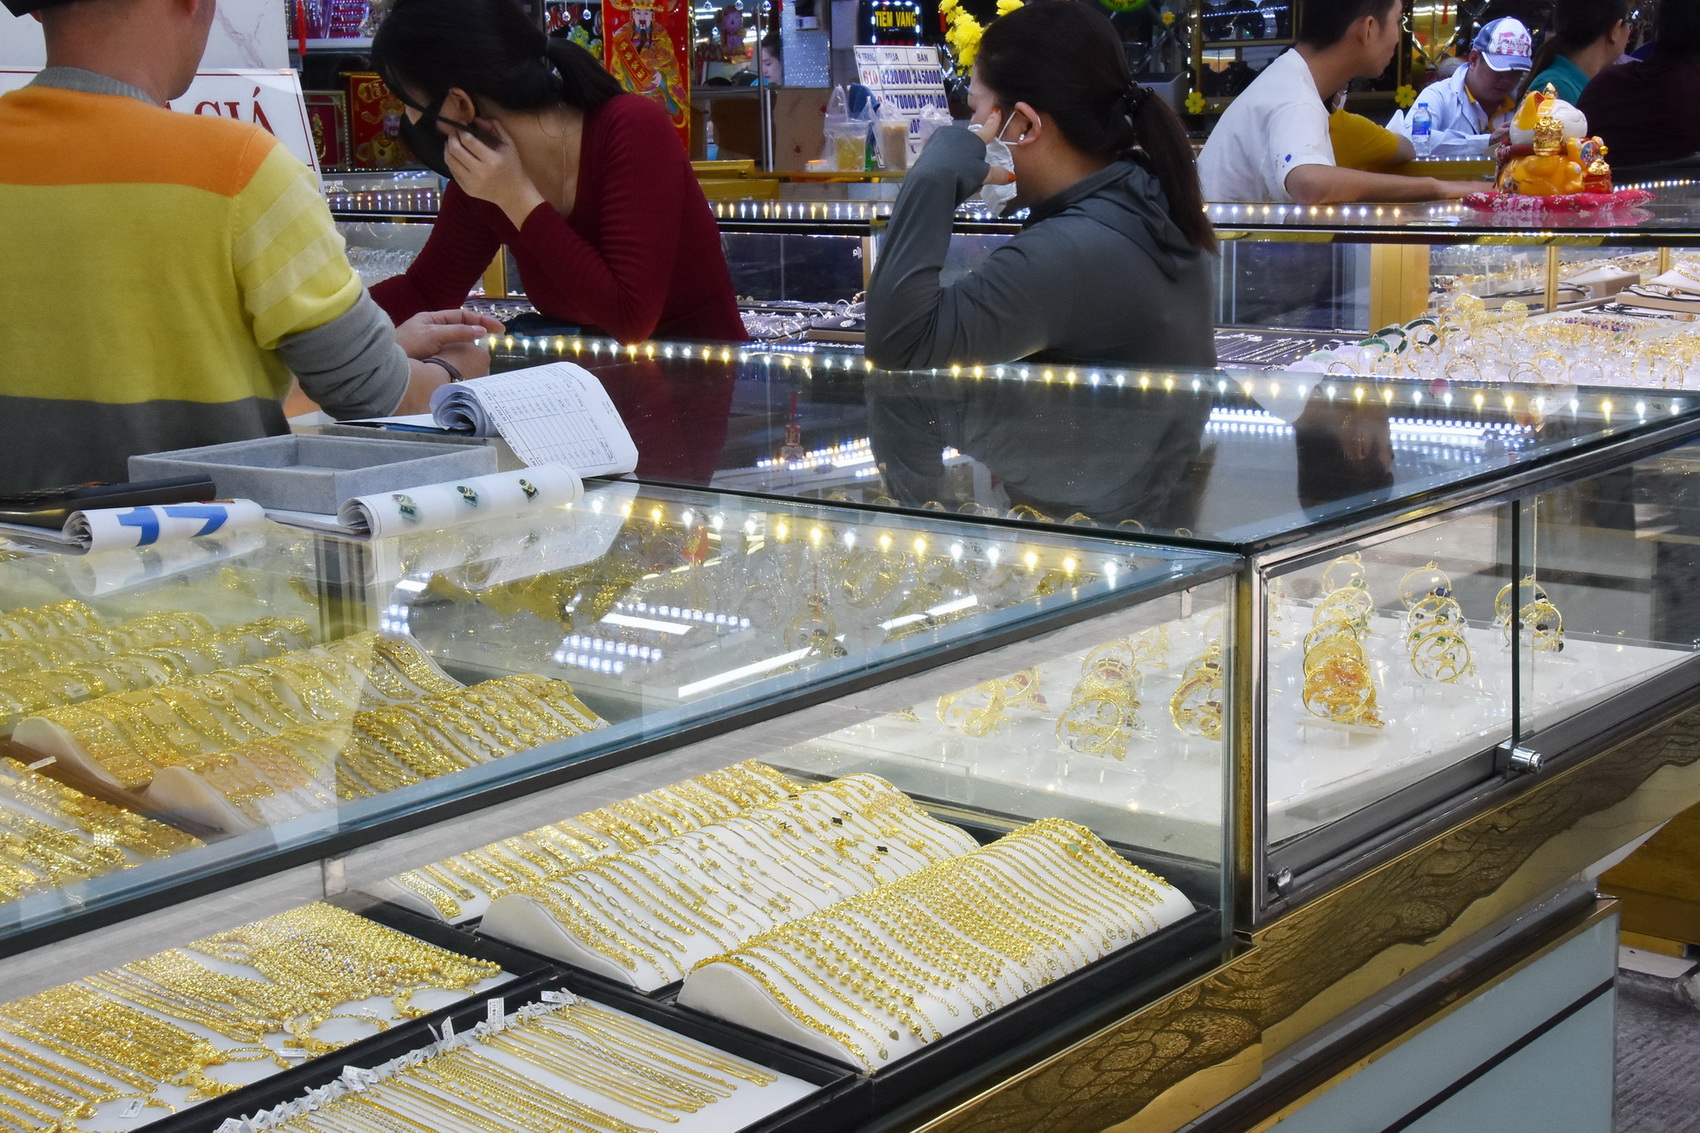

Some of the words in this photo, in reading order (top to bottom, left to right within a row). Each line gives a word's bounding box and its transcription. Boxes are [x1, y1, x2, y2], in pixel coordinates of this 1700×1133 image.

[895, 7, 917, 27] VÀNG
[917, 52, 928, 62] BÁN
[863, 70, 879, 85] 610
[881, 69, 912, 85] 3220000
[912, 69, 942, 85] 3450000
